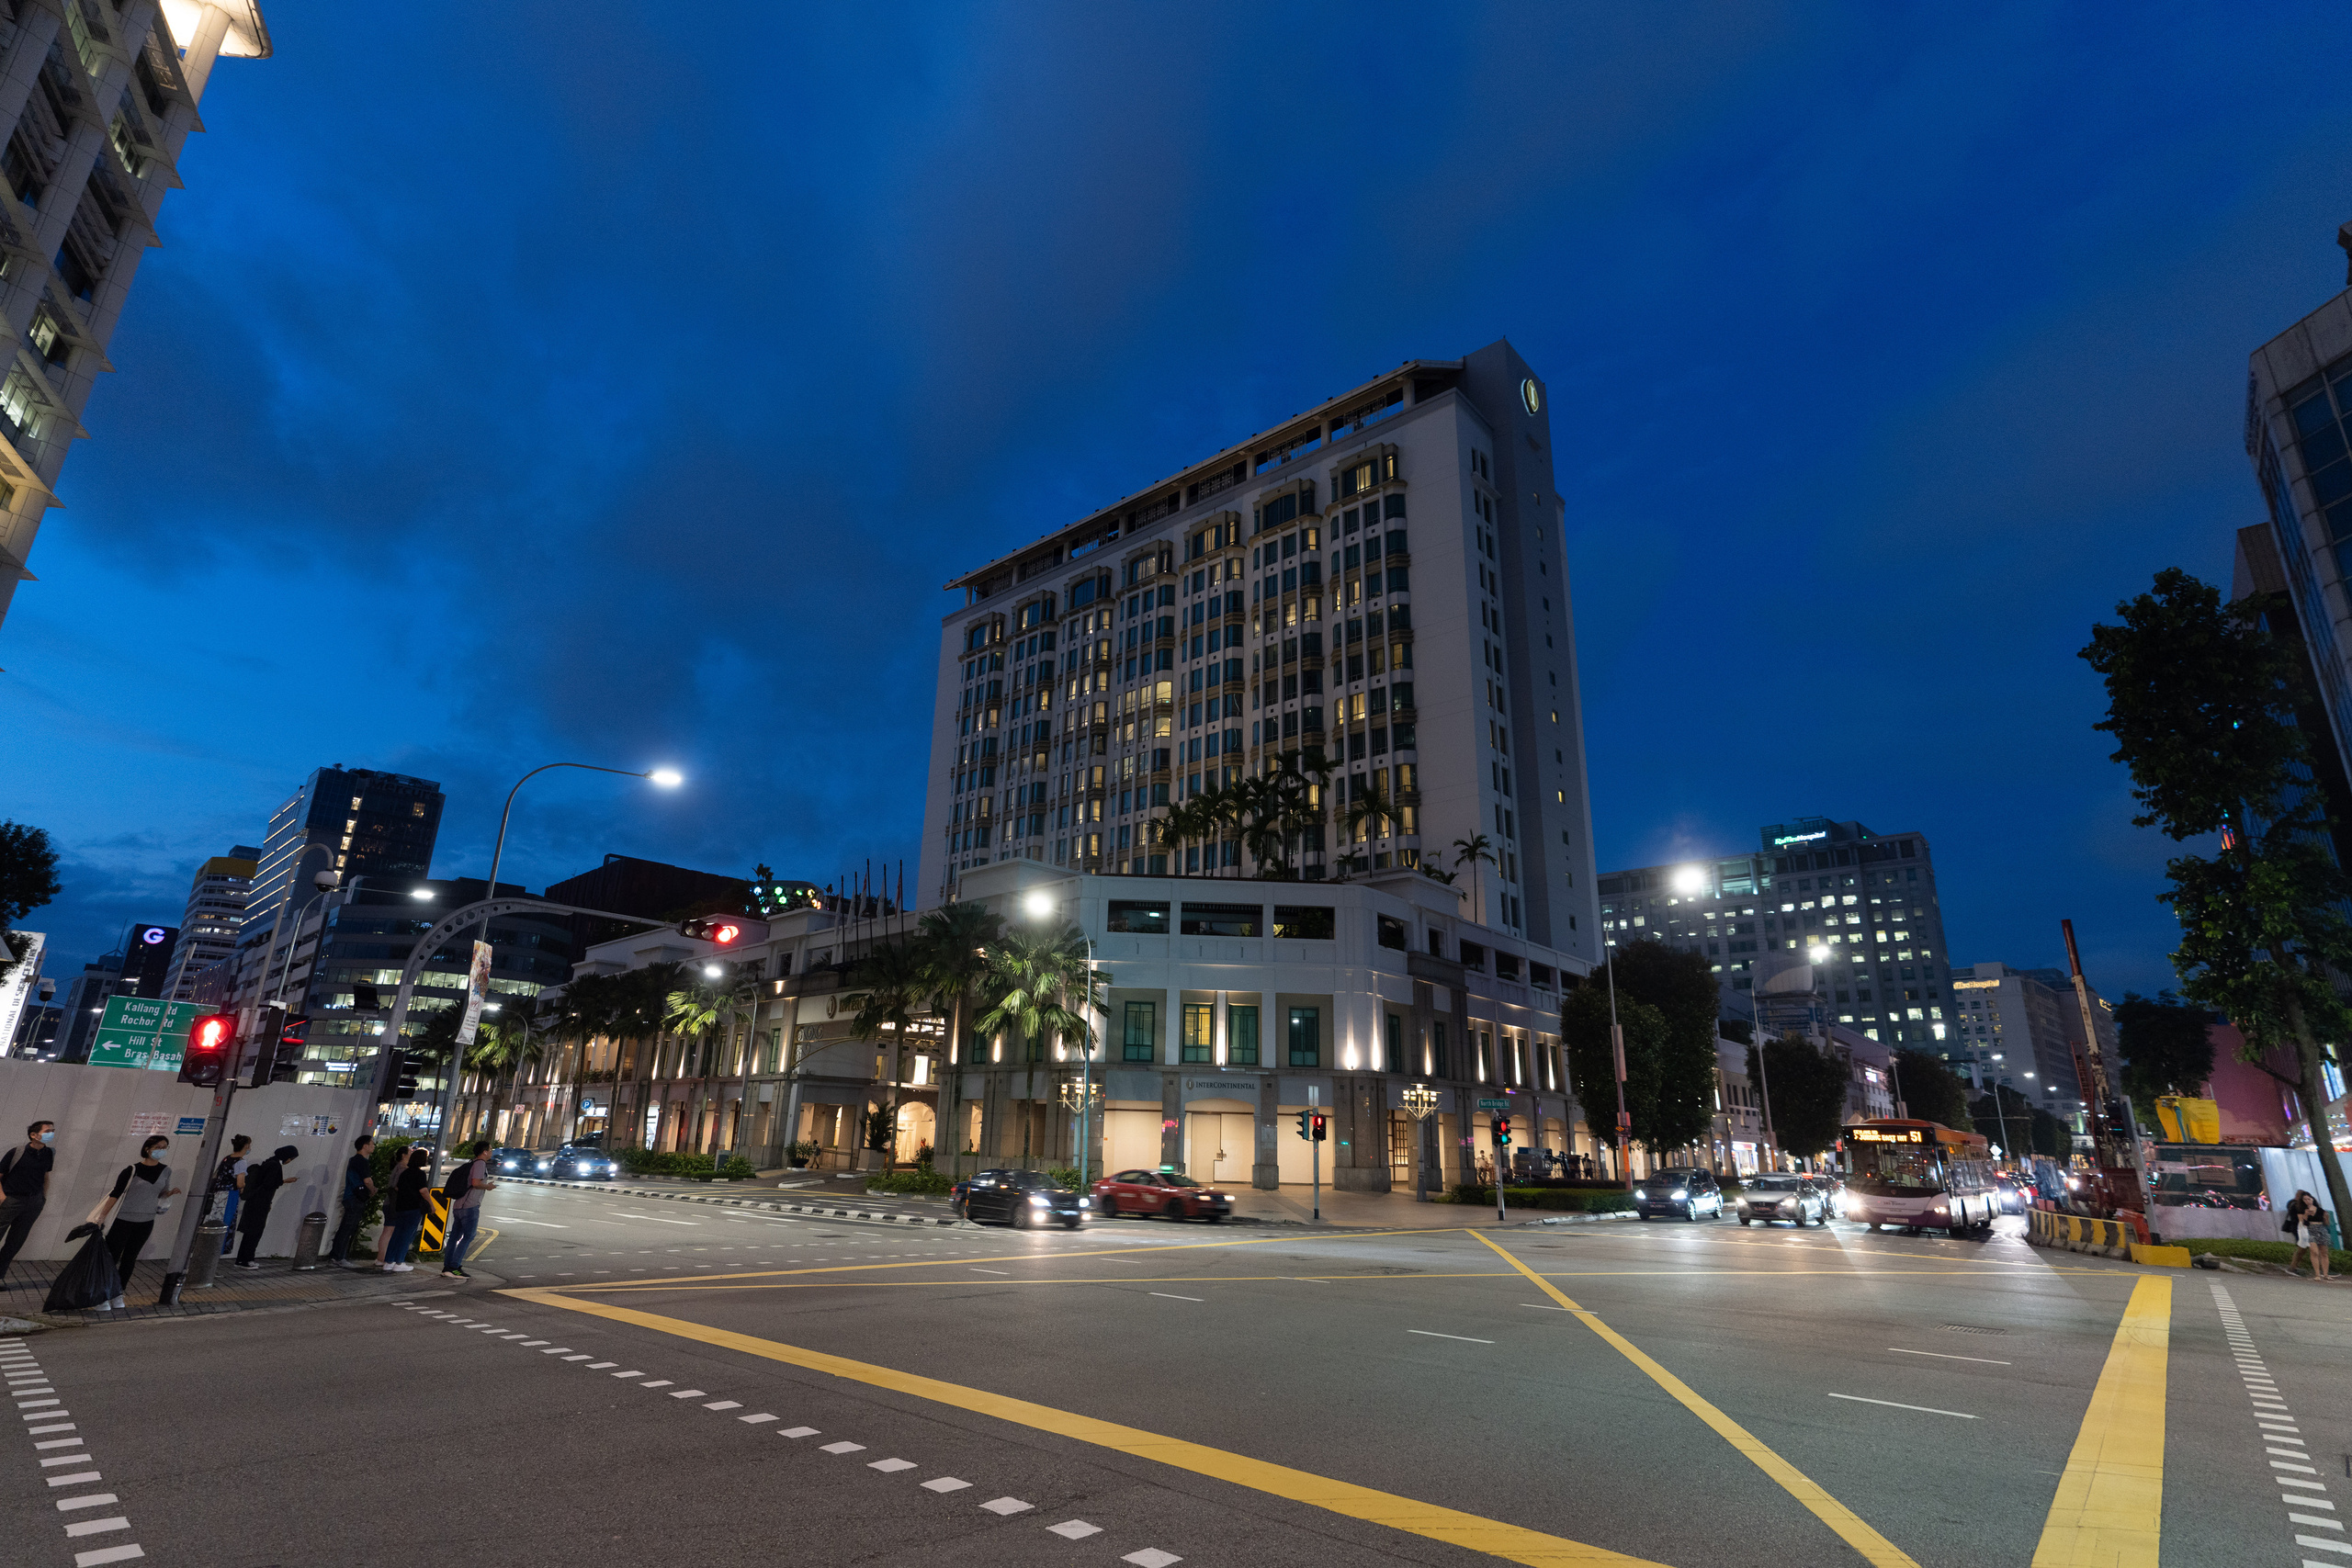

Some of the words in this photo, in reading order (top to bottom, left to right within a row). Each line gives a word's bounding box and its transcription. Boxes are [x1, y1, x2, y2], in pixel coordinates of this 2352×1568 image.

[143, 928, 165, 944] G
[125, 1001, 161, 1016] Kallang
[120, 1014, 156, 1026] Rochor
[129, 1035, 146, 1045] Hill
[124, 1048, 147, 1058] Bras
[153, 1050, 183, 1061] Basah
[1910, 1131, 1922, 1142] 51
